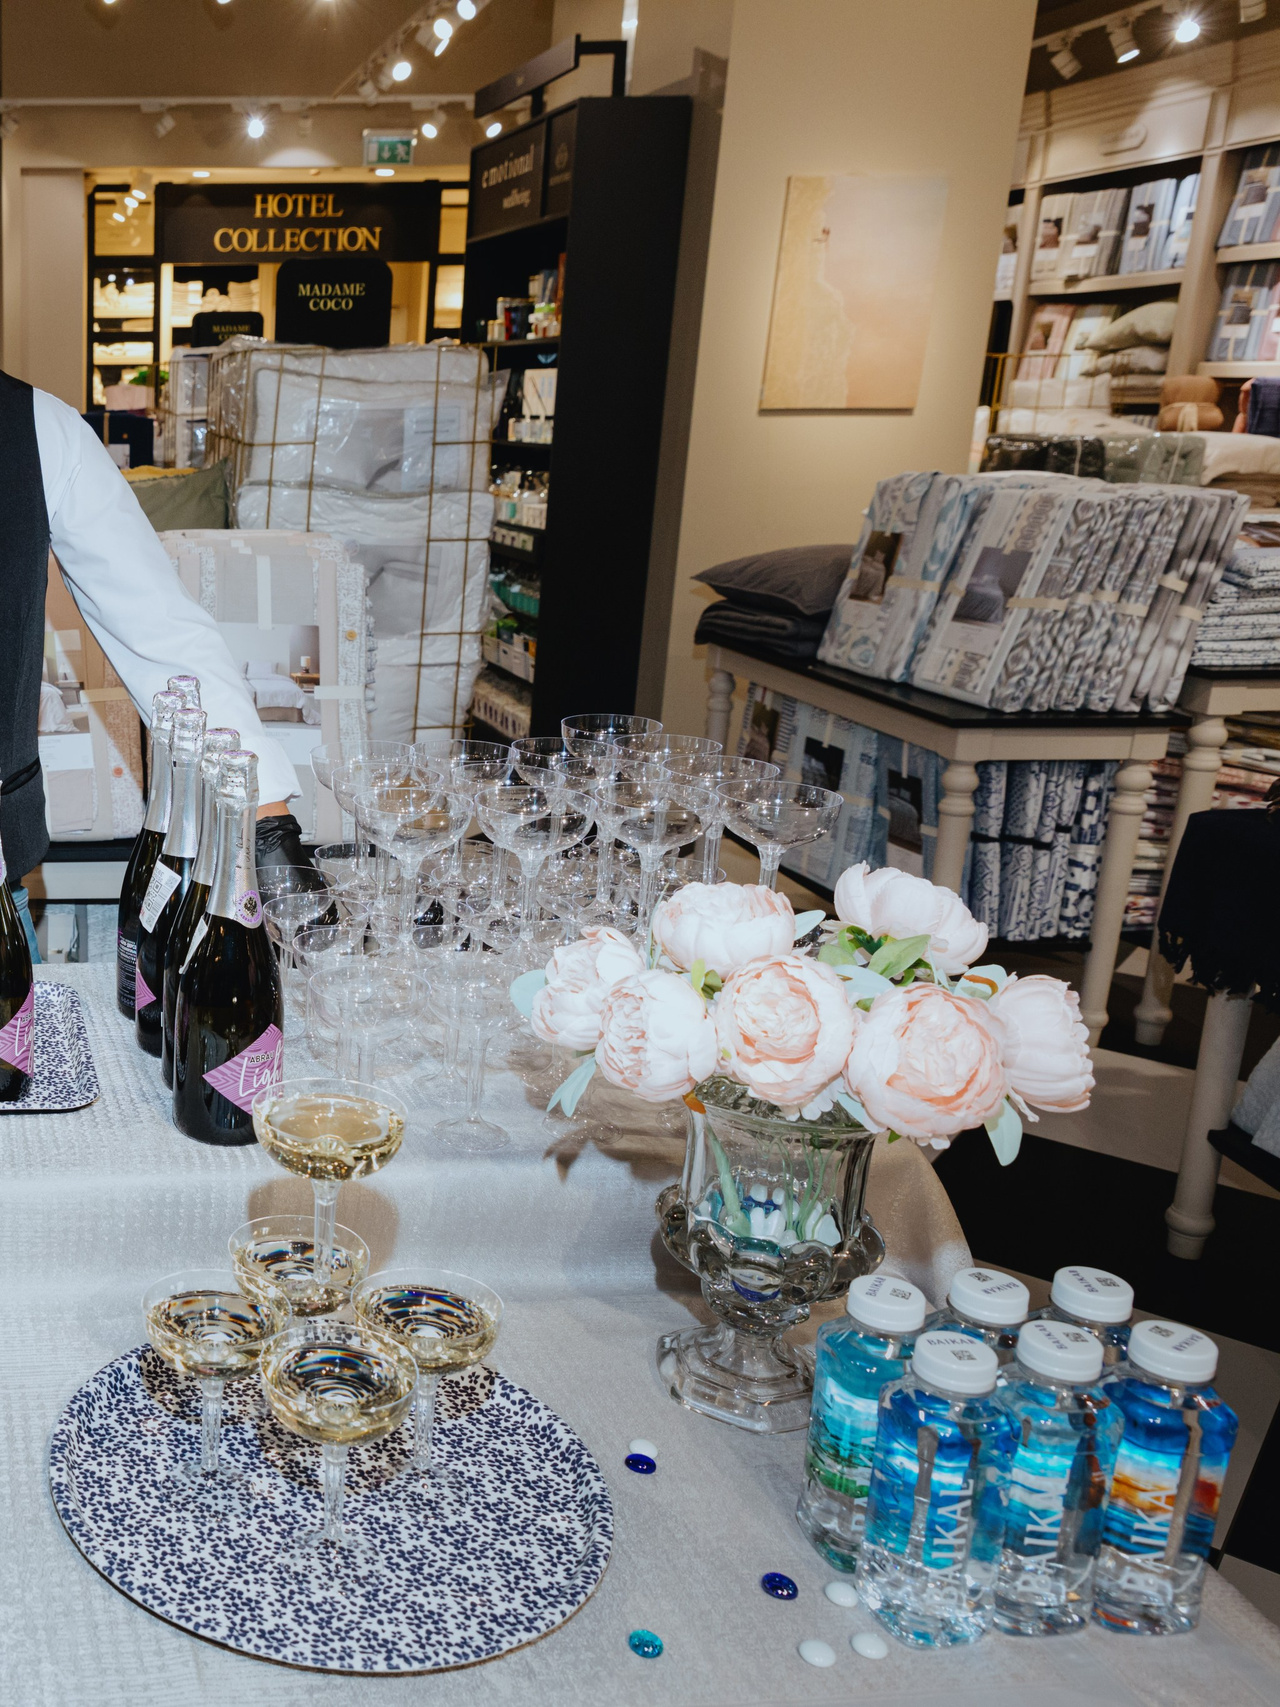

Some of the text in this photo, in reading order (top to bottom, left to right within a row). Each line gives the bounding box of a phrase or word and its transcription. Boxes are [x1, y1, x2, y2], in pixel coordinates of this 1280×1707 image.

[481, 143, 535, 189] emotional
[253, 193, 344, 219] HOTEL
[213, 226, 382, 253] COLLECTION
[298, 283, 366, 297] MADAME
[308, 298, 353, 311] COCO
[239, 1039, 284, 1098] Ligh
[926, 1478, 974, 1605] BAIKAL
